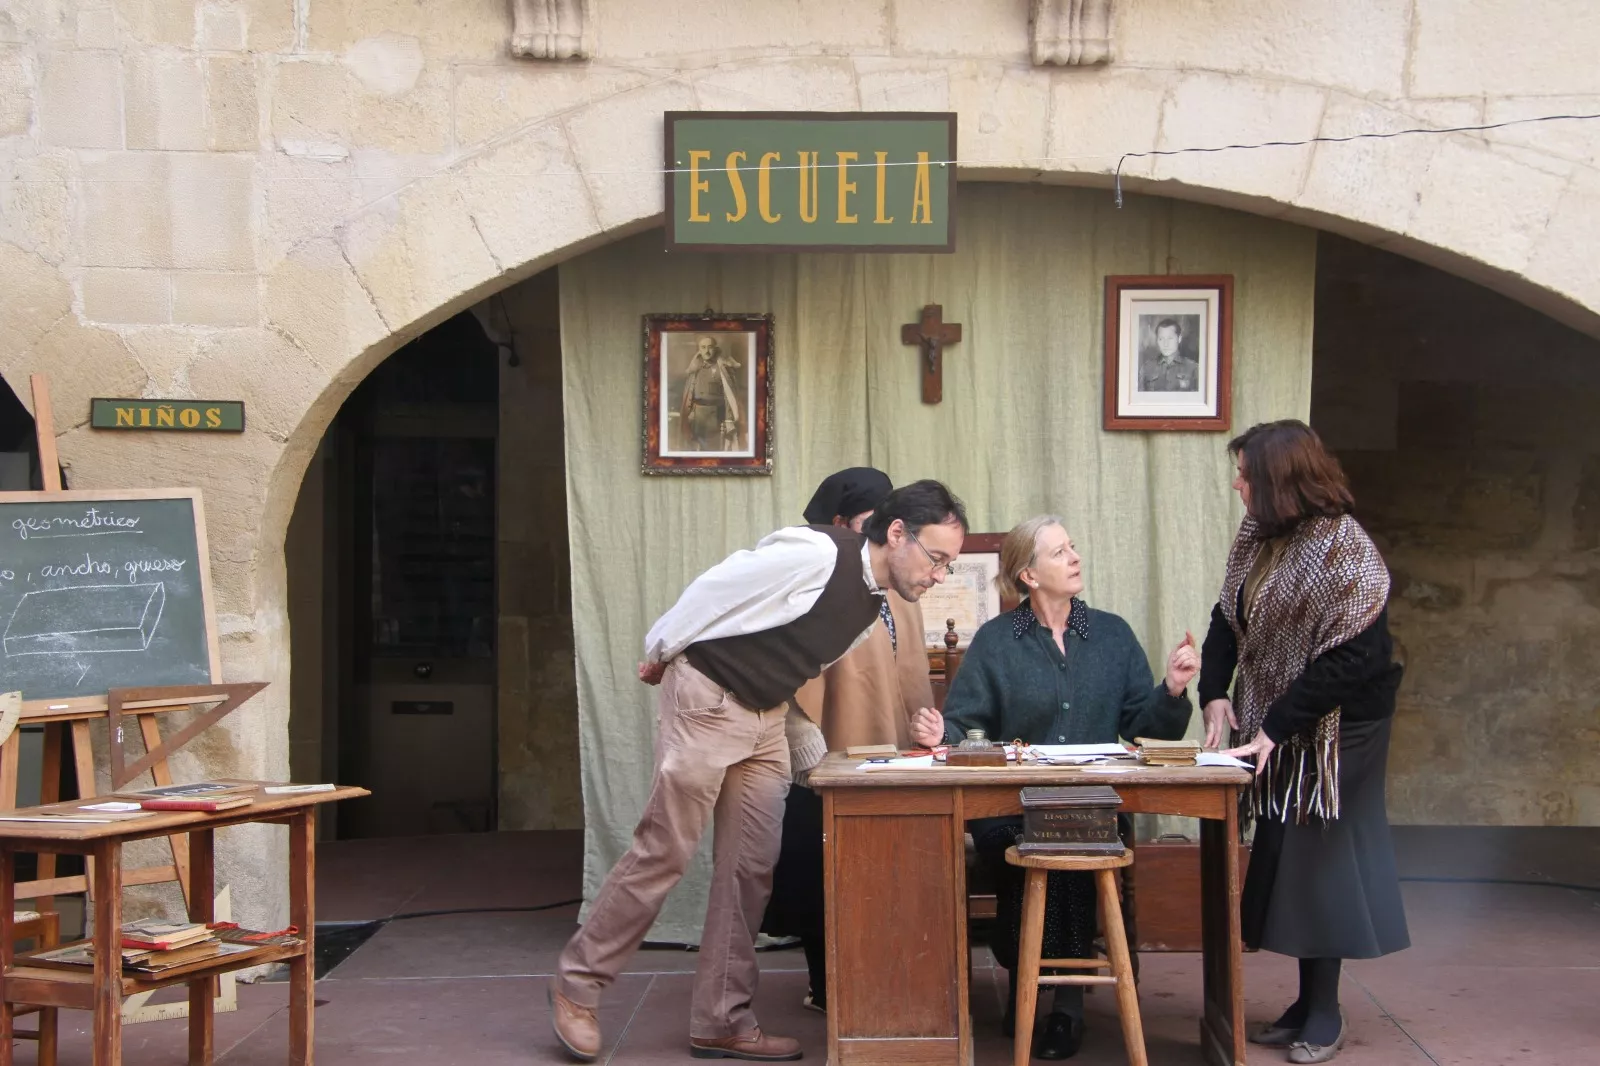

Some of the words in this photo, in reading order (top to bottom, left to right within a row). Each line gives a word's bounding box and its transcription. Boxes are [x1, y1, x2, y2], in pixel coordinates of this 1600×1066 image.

[687, 150, 934, 224] ESCUELA
[115, 404, 222, 428] NIÑOS
[124, 559, 187, 583] grueso
